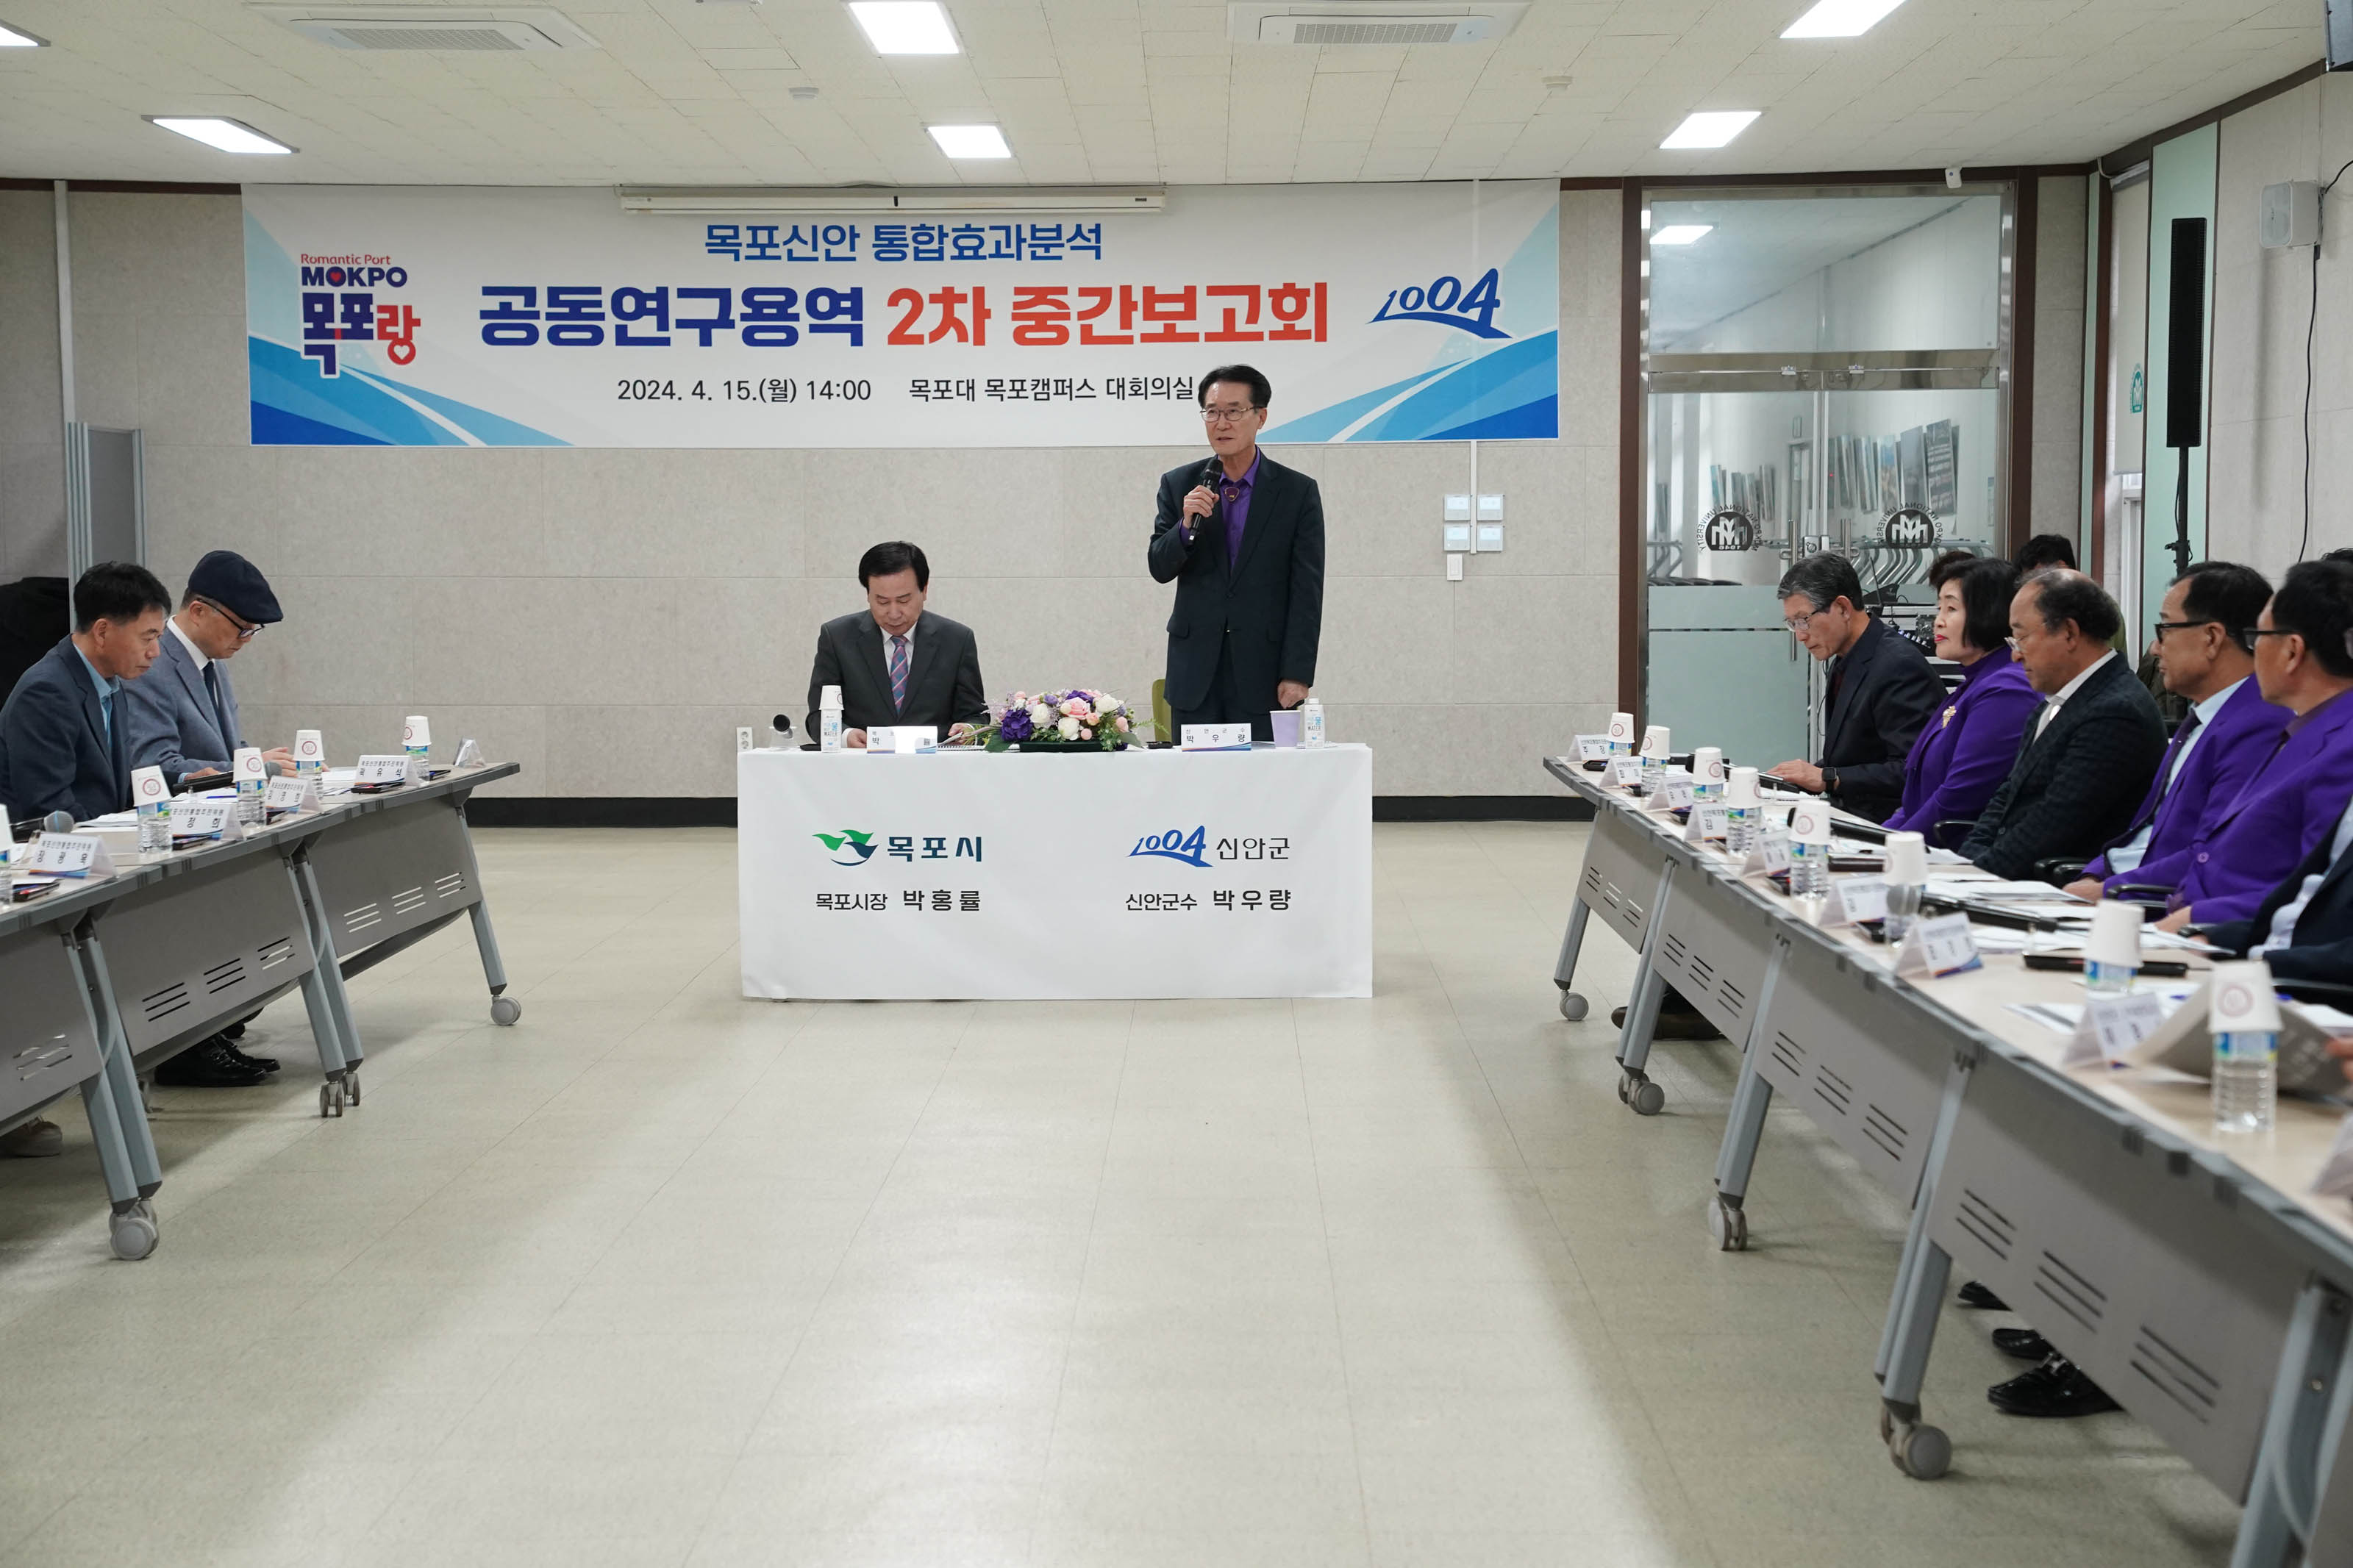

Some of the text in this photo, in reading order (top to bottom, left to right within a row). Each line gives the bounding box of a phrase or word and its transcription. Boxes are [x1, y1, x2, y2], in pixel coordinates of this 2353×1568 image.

[704, 223, 1101, 263] 목포신안 통합효과분석
[301, 253, 391, 265] Romantic Port
[301, 266, 407, 288] MOKPO
[479, 282, 1328, 348] 공동연구용역 2차 중간보고회
[1368, 268, 1507, 336] 1004
[618, 378, 871, 404] 2024. 4. 15.(월) 14:00
[909, 376, 1193, 403] 목포대 목포캠퍼스 대회의실
[887, 836, 982, 862] 목포시
[1129, 825, 1213, 867] 1004
[1215, 837, 1290, 860] 신안군
[815, 889, 981, 912] 목포시장 박홍률
[1125, 889, 1292, 912] 신안군수 박우량
